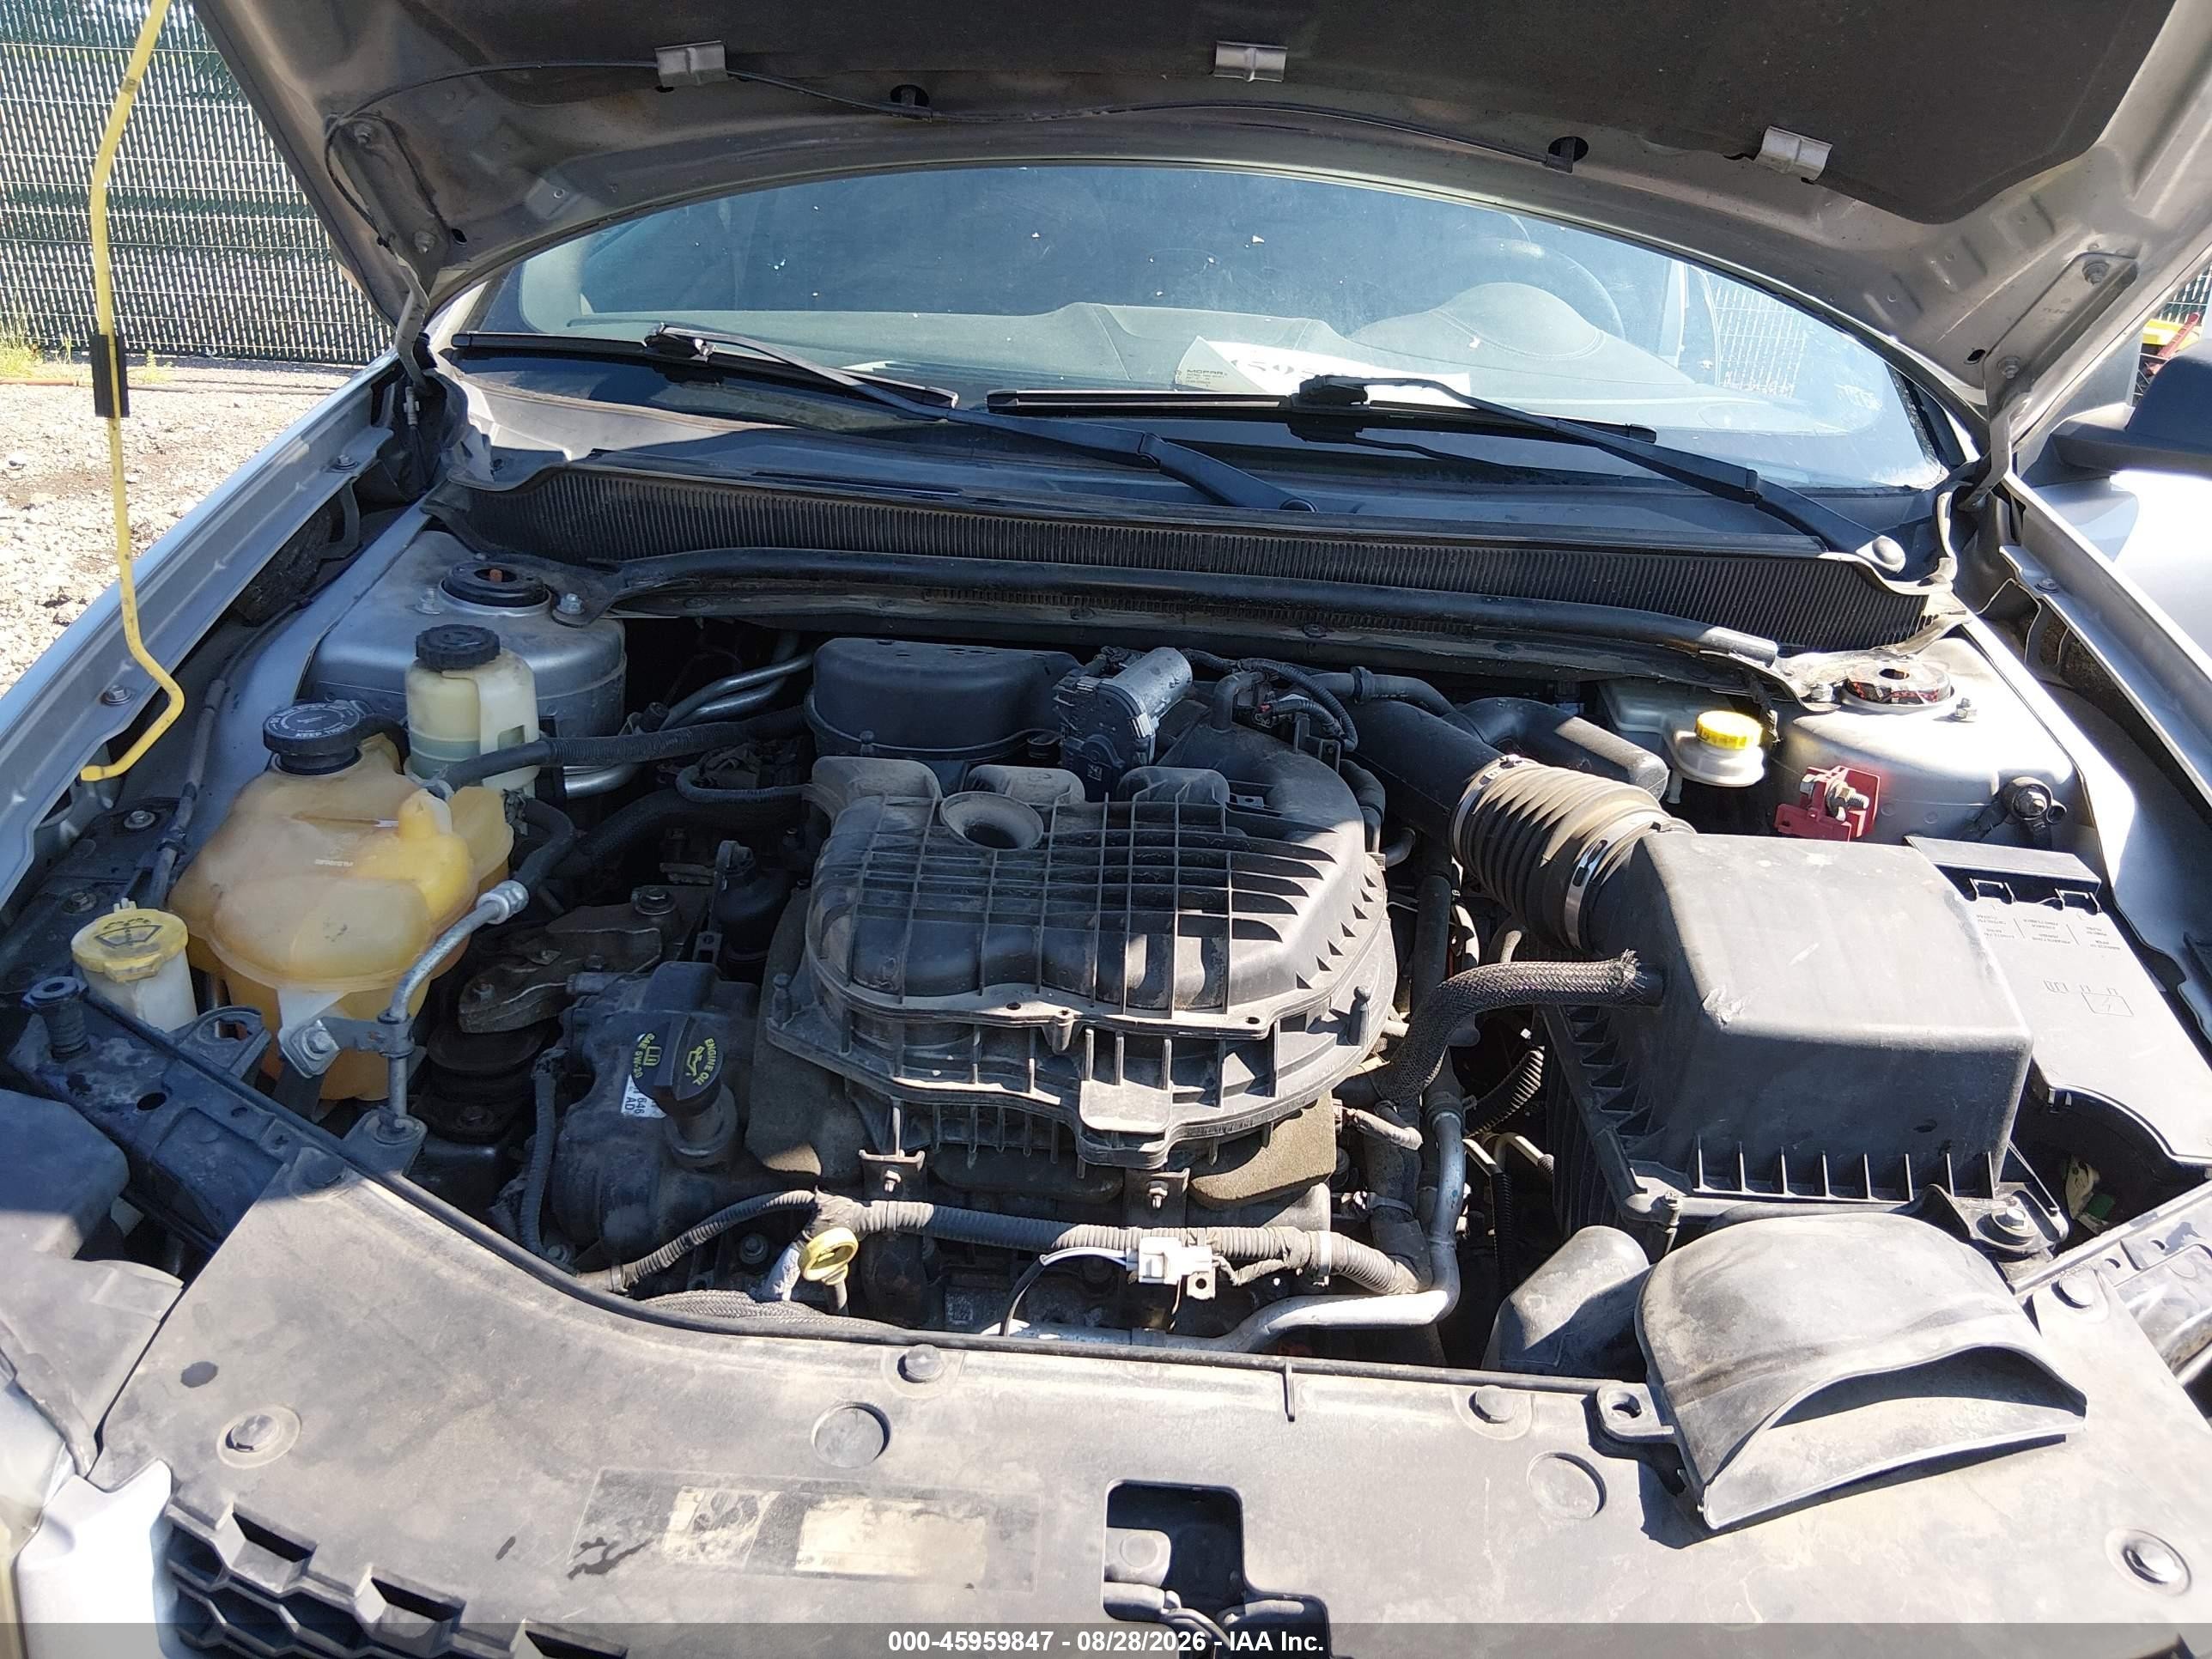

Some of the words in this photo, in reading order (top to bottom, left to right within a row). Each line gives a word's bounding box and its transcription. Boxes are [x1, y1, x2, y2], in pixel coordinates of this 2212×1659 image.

[638, 1033, 656, 1049] SAE
[703, 1037, 718, 1072] ENGINE
[692, 1072, 710, 1086] OIL
[625, 1097, 637, 1110] AD
